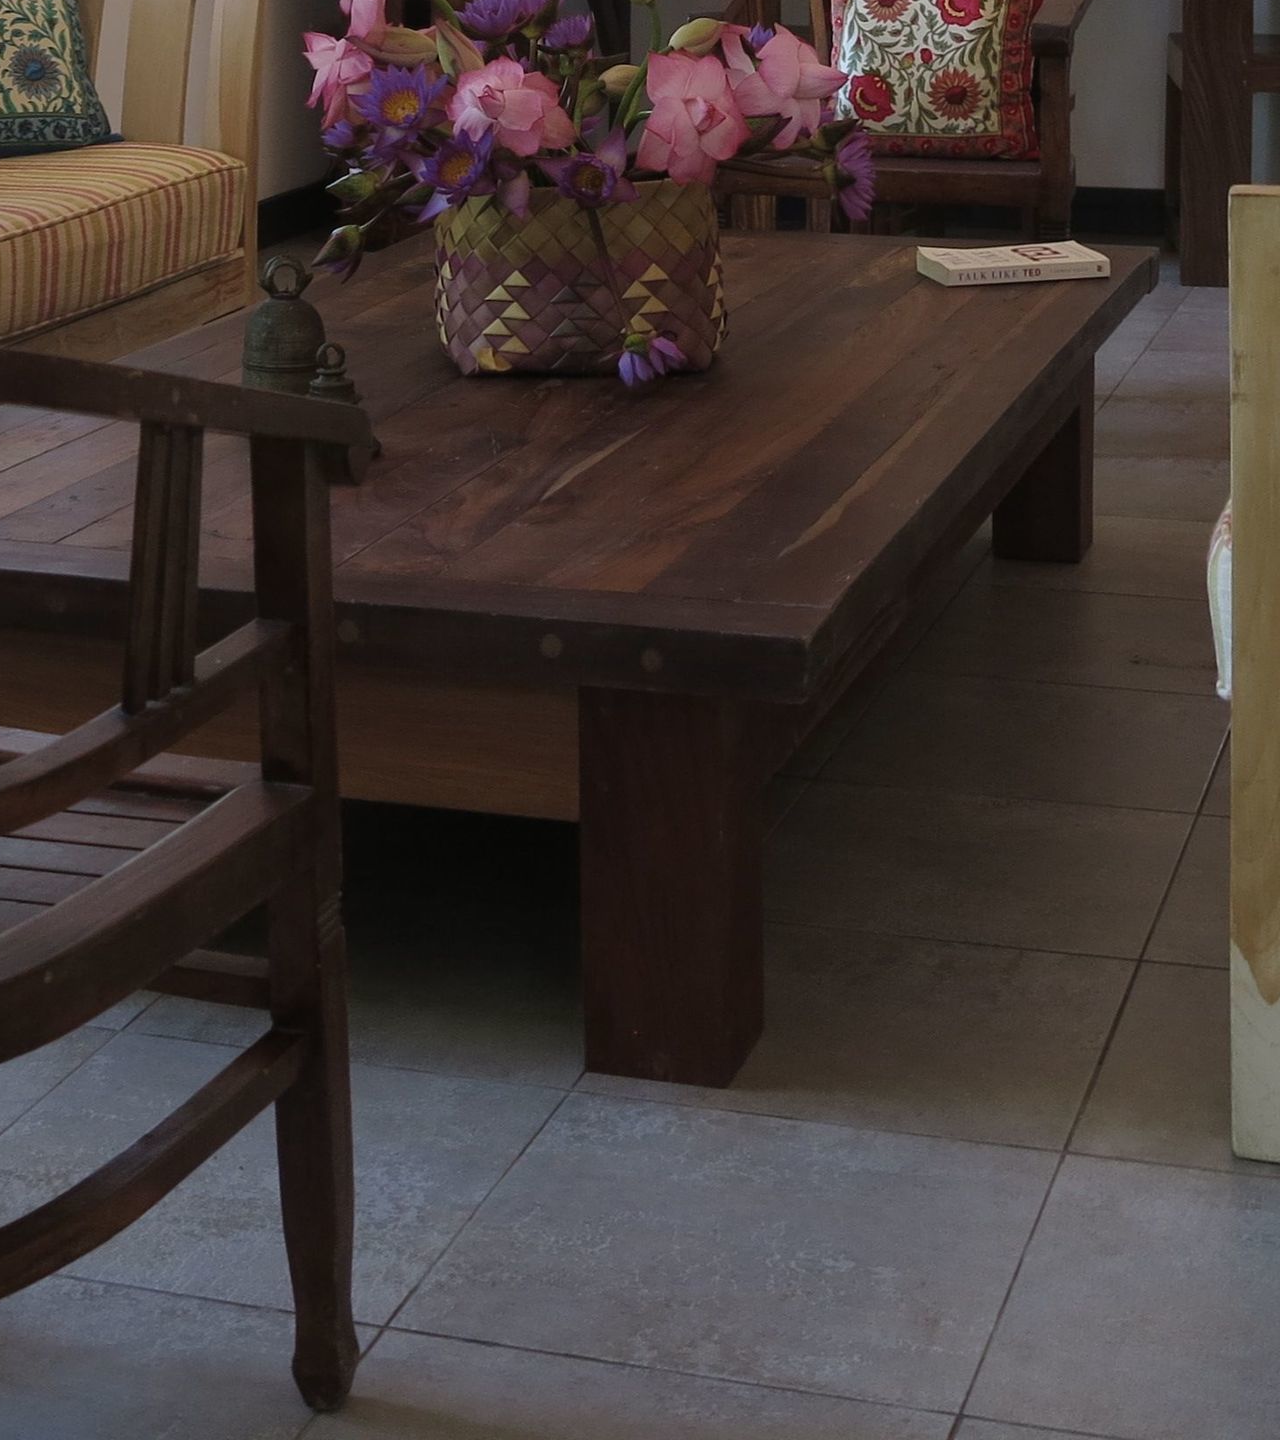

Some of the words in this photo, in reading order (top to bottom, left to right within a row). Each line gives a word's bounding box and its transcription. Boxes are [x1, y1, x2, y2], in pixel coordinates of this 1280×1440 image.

[958, 271, 987, 282] TALK
[991, 269, 1018, 280] LIKE
[1022, 268, 1041, 277] TED
